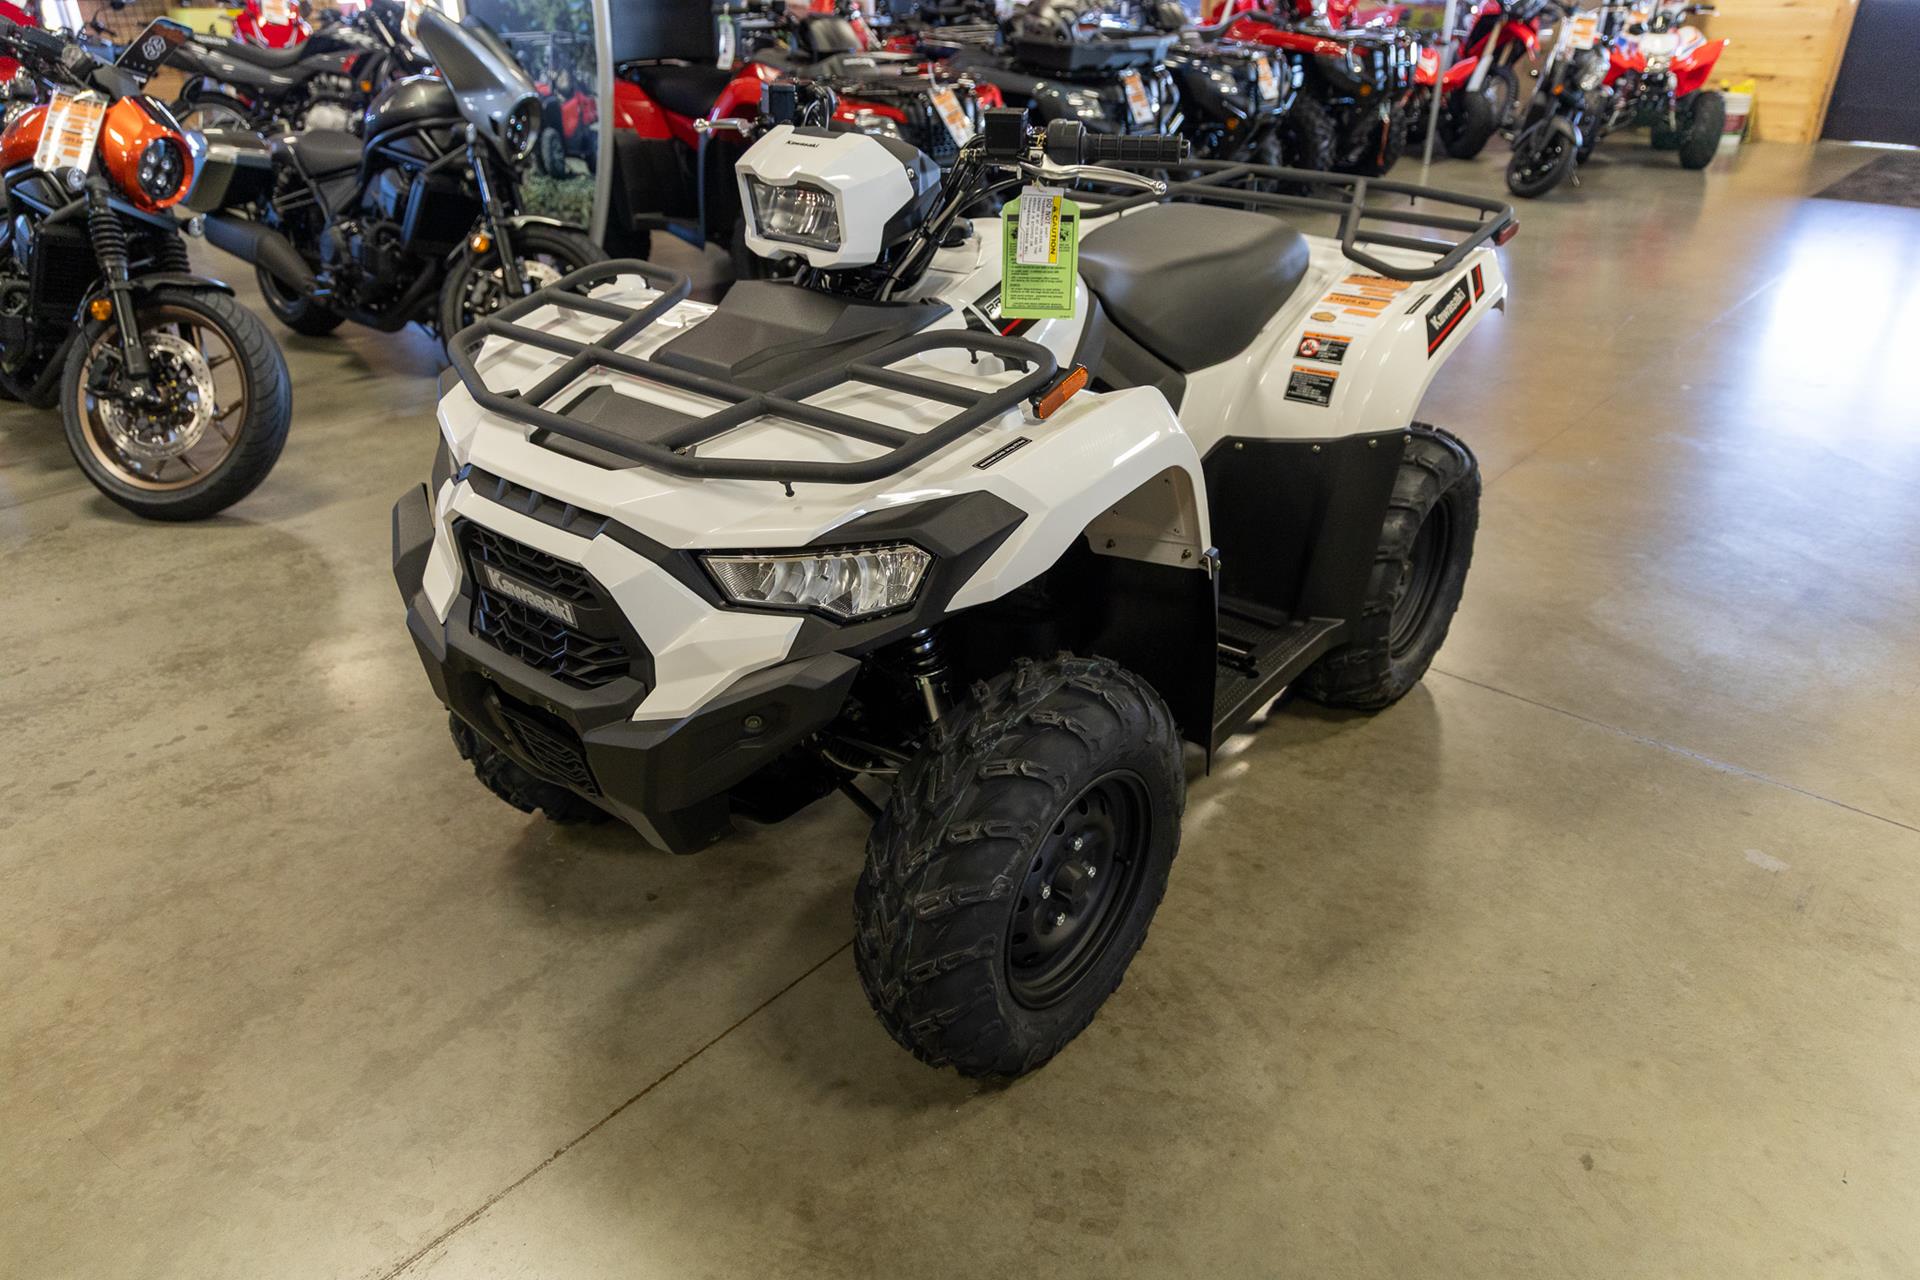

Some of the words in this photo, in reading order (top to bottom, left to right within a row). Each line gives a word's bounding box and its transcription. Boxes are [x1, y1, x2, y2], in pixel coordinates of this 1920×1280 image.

[1047, 199, 1052, 207] DO
[1429, 287, 1466, 331] Kawasaki
[487, 568, 574, 625] Kawasaki
